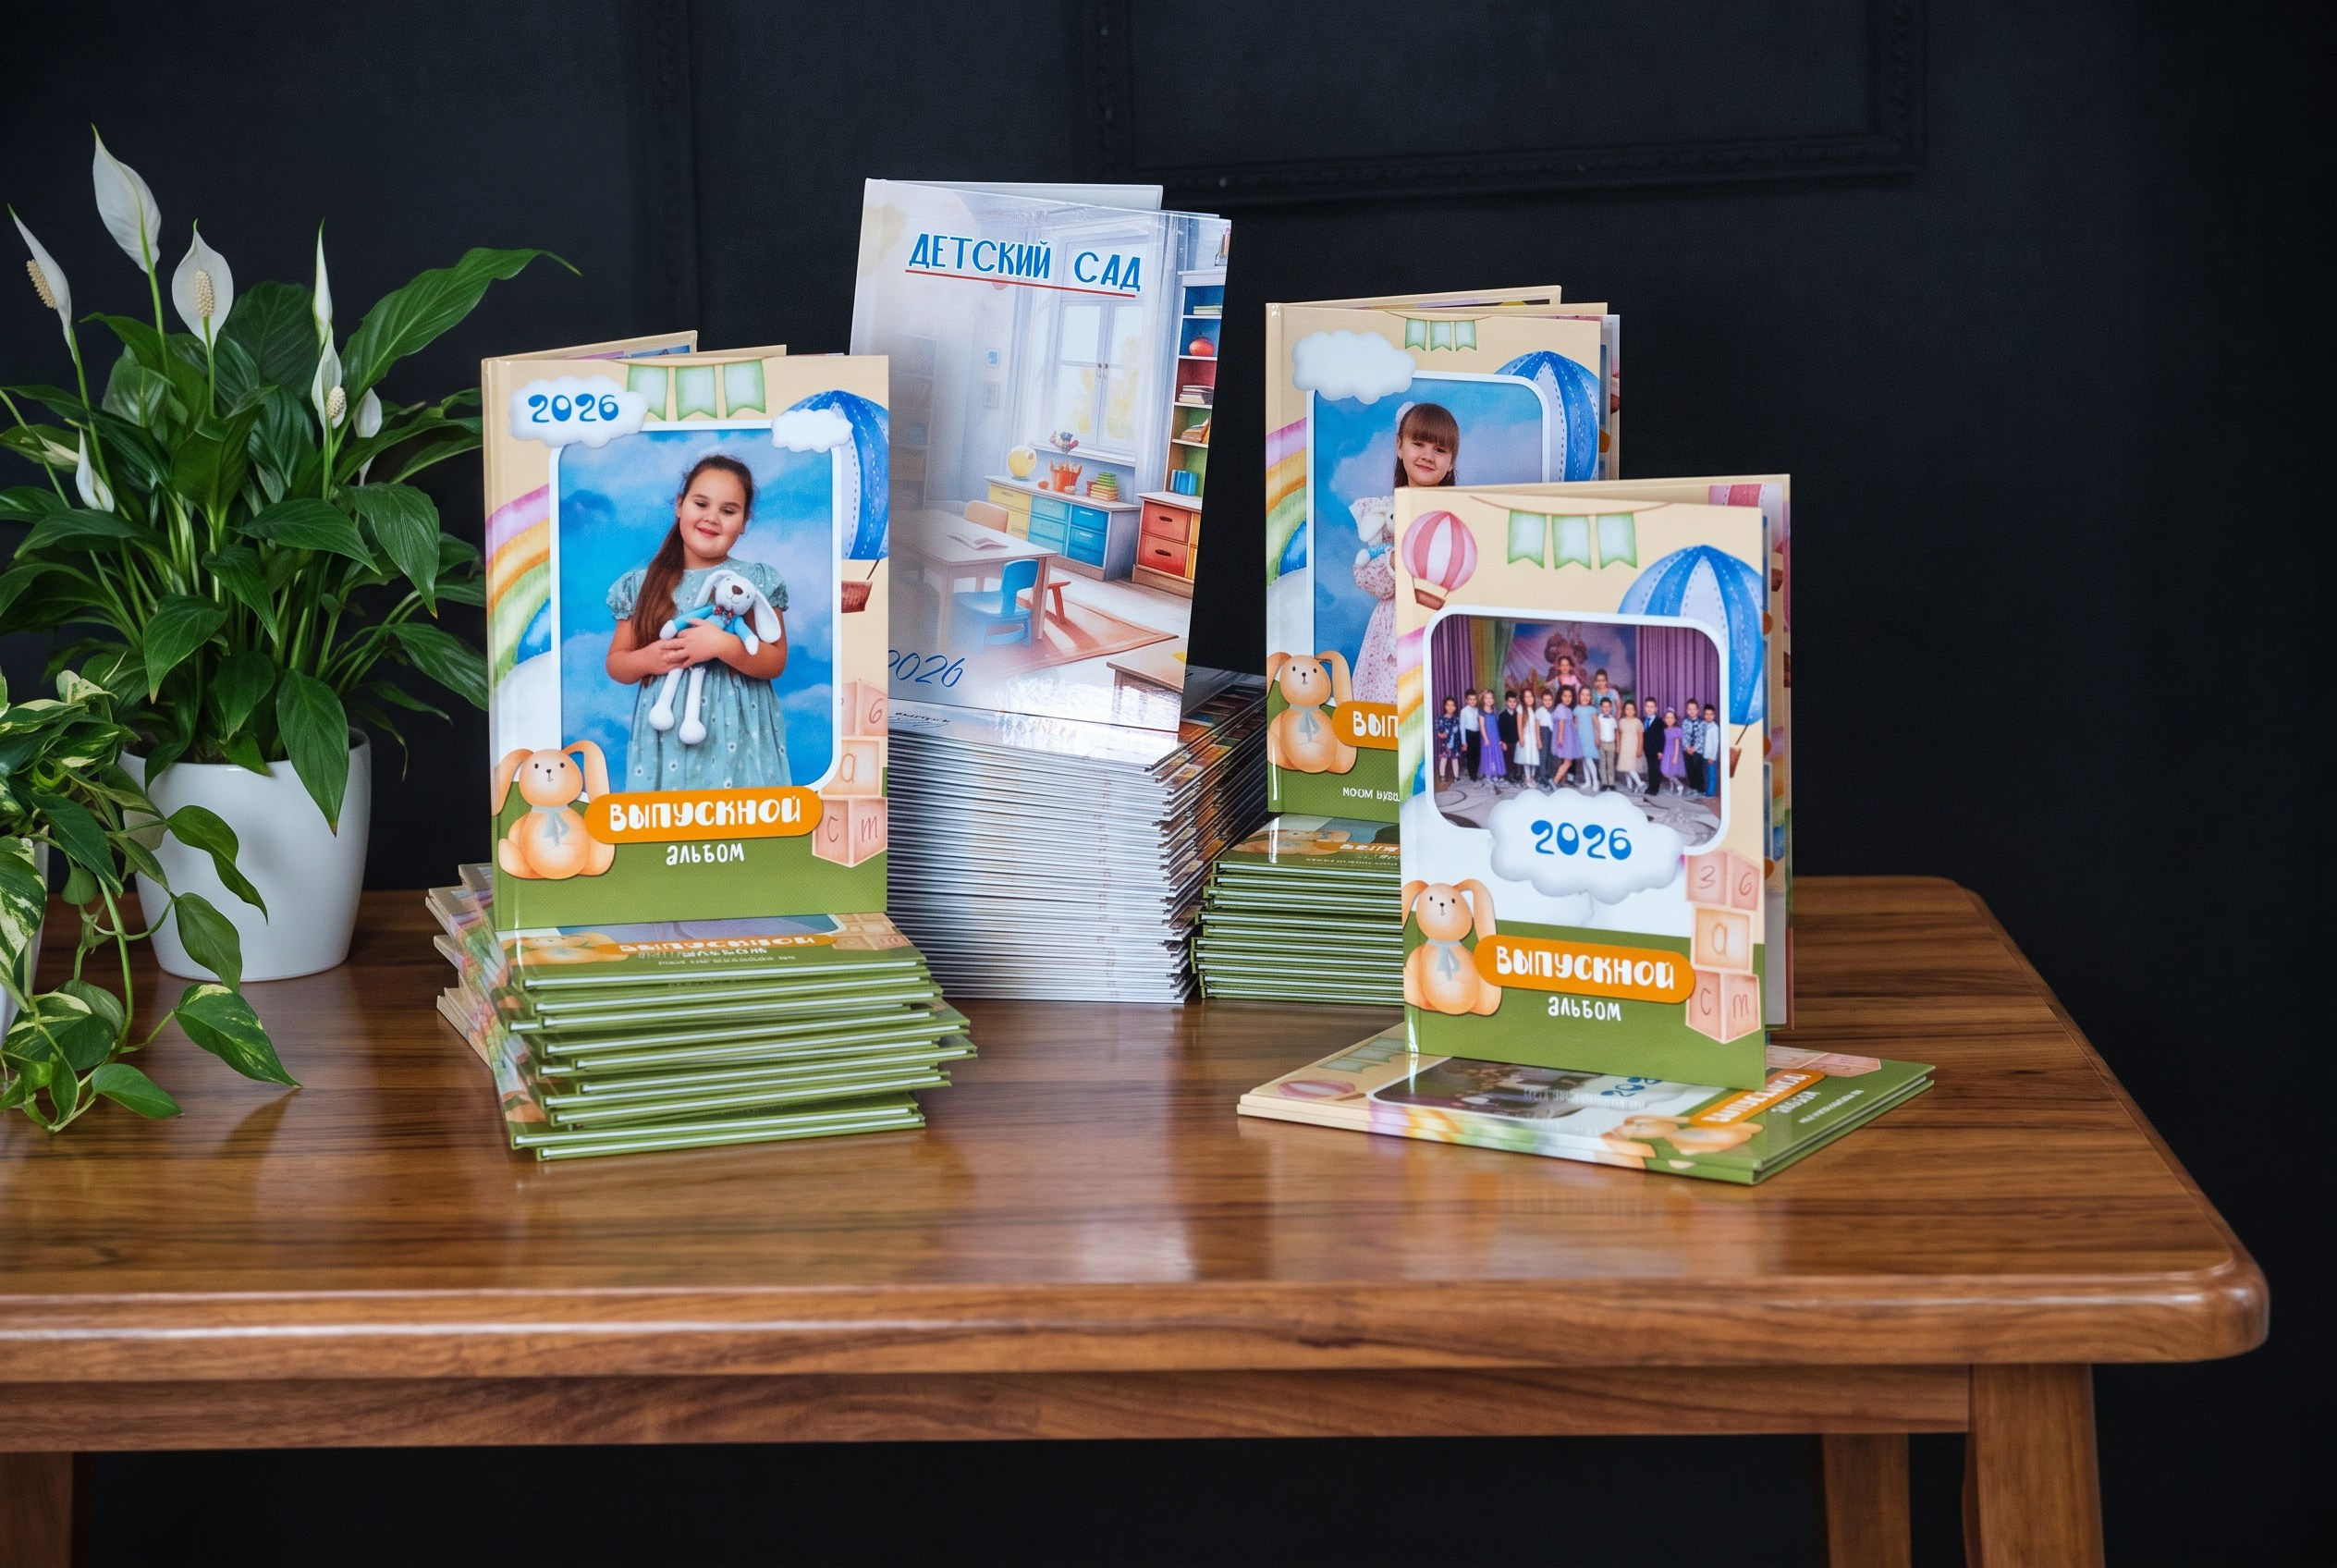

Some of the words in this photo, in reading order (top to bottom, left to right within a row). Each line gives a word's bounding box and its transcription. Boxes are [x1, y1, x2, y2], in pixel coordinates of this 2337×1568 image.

[908, 233, 1052, 279] ДЕТСКИЙ
[1073, 251, 1142, 292] САД
[528, 393, 619, 423] 2026
[609, 795, 801, 832] ВЫПУСКНОЙ
[1530, 819, 1633, 860] 2026
[1496, 945, 1675, 990] ВЫПУСКНОЙ
